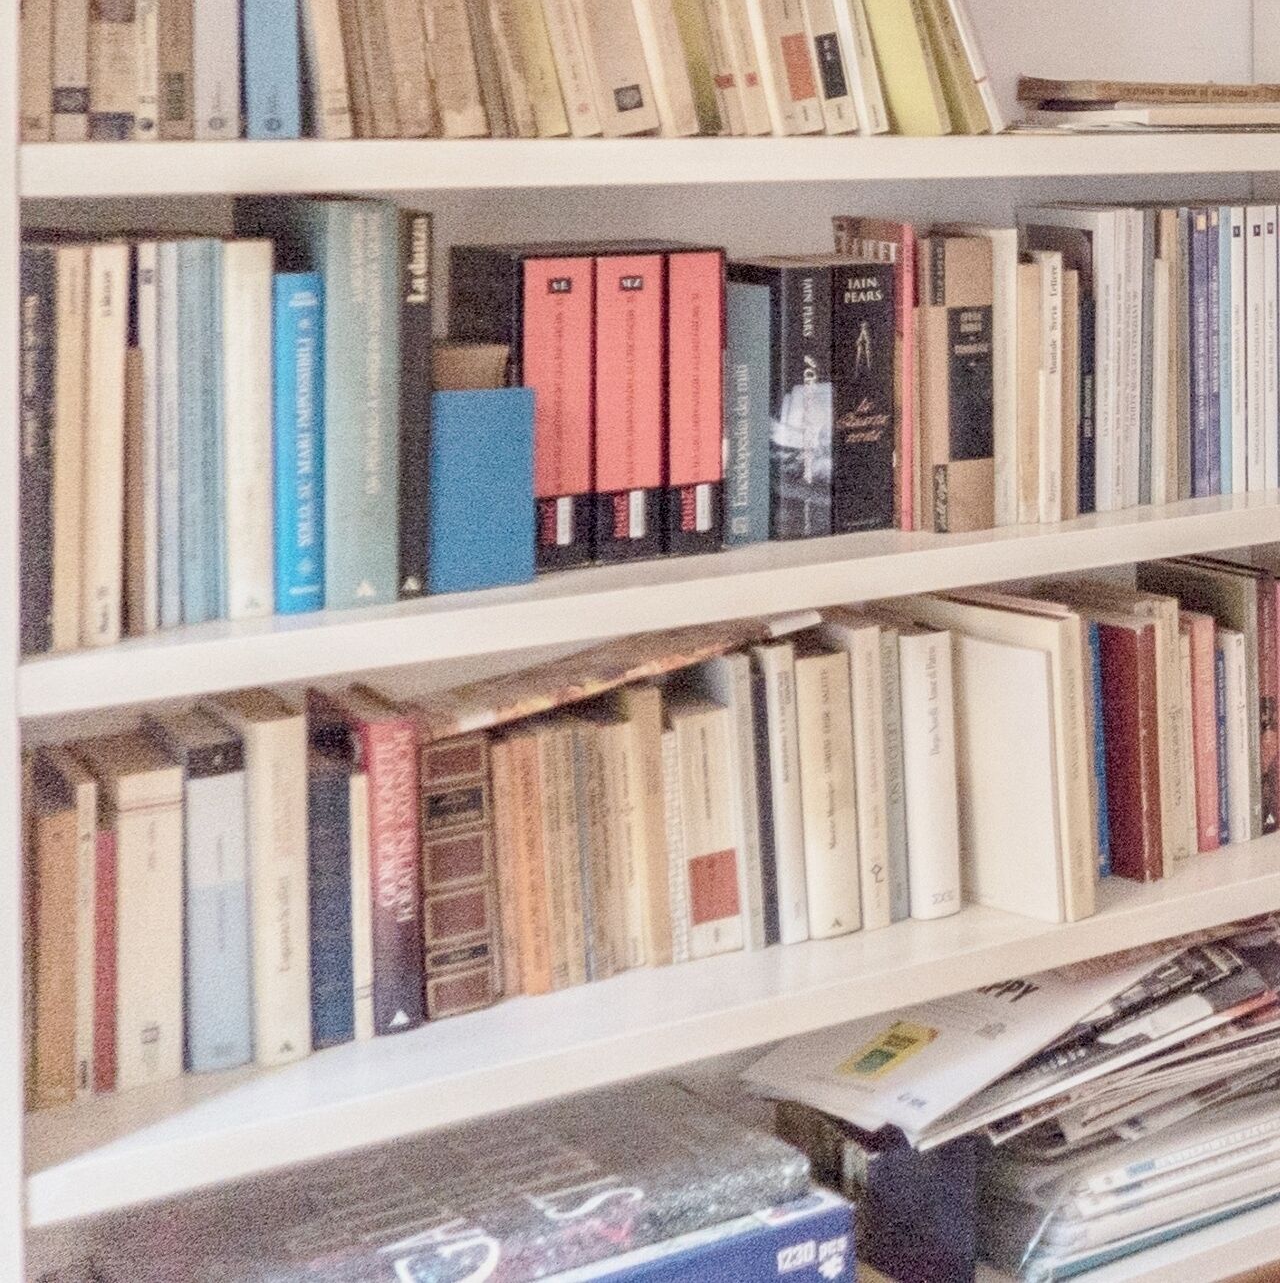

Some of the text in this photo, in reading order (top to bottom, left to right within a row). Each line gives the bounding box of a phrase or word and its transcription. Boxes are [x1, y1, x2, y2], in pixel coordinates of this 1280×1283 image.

[406, 217, 428, 304] La danza
[843, 289, 883, 304] PEARS
[847, 278, 879, 288] IAIN
[803, 305, 813, 338] PEARS
[733, 364, 749, 508] Enciclopedia dei miti
[778, 1240, 817, 1272] 1230
